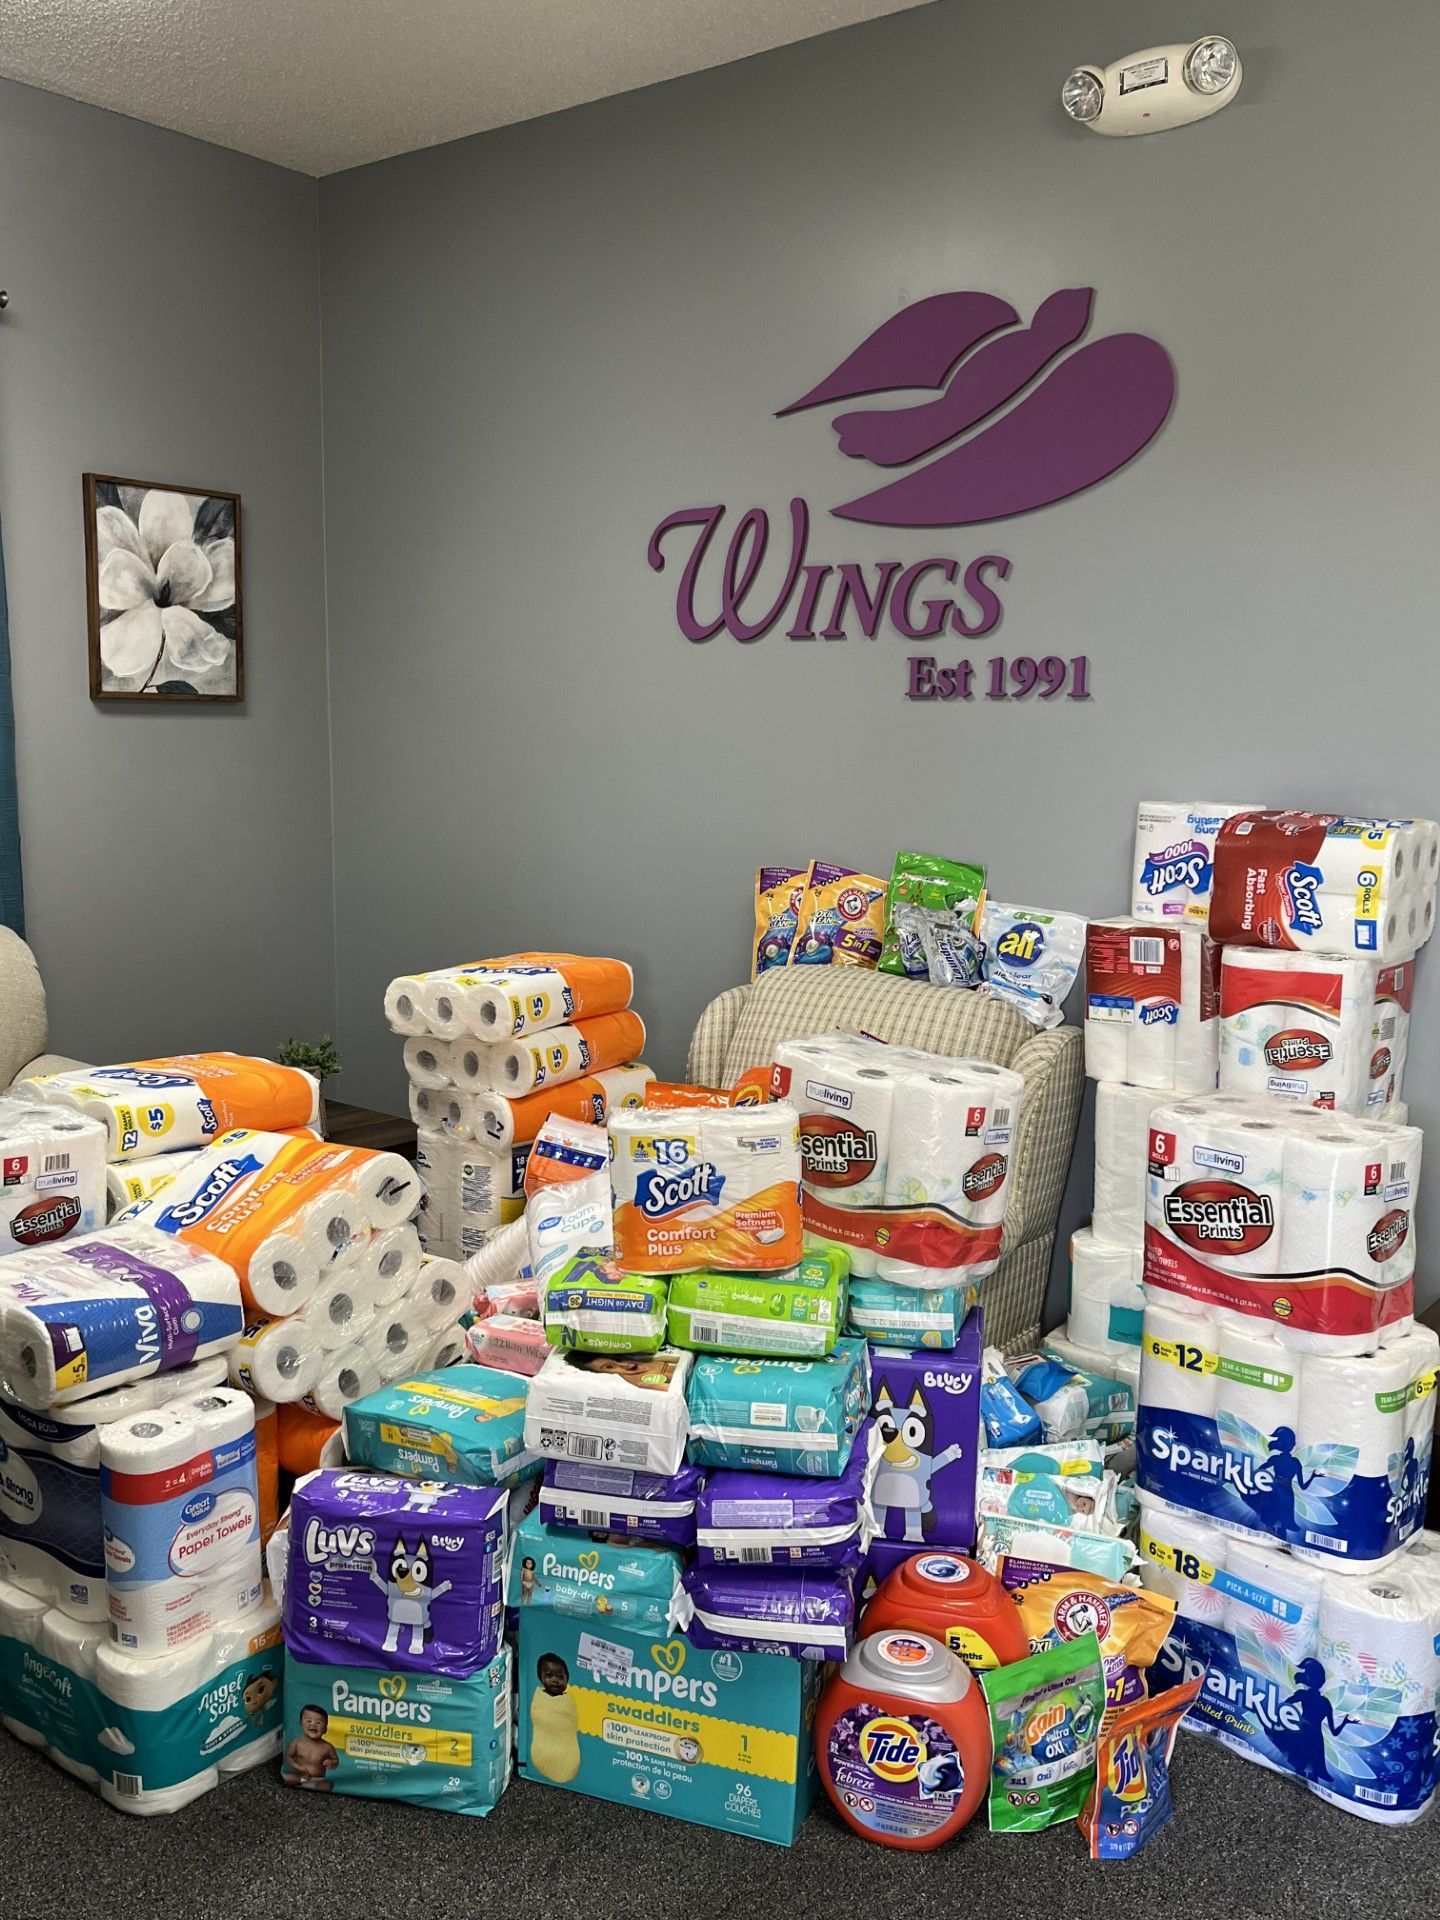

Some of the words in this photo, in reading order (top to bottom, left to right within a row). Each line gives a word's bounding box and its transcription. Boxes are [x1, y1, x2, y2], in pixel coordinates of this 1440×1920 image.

[906, 656, 973, 699] Est
[986, 655, 1091, 699] 1991
[1164, 840, 1194, 859] 1000
[1150, 858, 1204, 895] Scott
[1256, 868, 1268, 894] Fast
[1357, 871, 1378, 886] 6
[1241, 867, 1257, 930] Absorbing
[1290, 871, 1323, 929] Scott
[1361, 888, 1370, 914] ROLLS
[999, 930, 1040, 960] all
[533, 996, 544, 1017] $5
[562, 987, 574, 1015] Scott
[1145, 1005, 1174, 1024] Scott
[513, 1015, 524, 1035] 12
[1281, 1038, 1309, 1047] Prints
[553, 1048, 563, 1069] $5
[580, 1041, 590, 1070] Scott
[1265, 1043, 1332, 1064] Essential
[534, 1067, 546, 1085] 12
[773, 1066, 782, 1086] 6
[809, 1083, 850, 1107] trueliving
[150, 1107, 165, 1131] $5
[202, 1101, 218, 1131] Scott
[592, 1096, 604, 1123] Scott
[973, 1108, 982, 1122] 6
[122, 1130, 138, 1152] 12
[222, 1131, 248, 1145] $5
[1155, 1133, 1166, 1154] 6
[516, 1156, 525, 1165] 18
[636, 1140, 645, 1149] 4
[653, 1140, 687, 1164] 16
[1151, 1151, 1169, 1162] ROLLS
[1196, 1150, 1241, 1171] trueliving
[12, 1158, 20, 1171] 6
[807, 1156, 848, 1173] Prints
[963, 1156, 1008, 1191] Essential
[1370, 1165, 1377, 1180] 6
[37, 1173, 76, 1188] trueliving
[645, 1163, 713, 1213] Scott
[171, 1161, 243, 1226] Scott
[205, 1169, 289, 1232] Comfort
[10, 1196, 82, 1237] Essential
[217, 1200, 264, 1235] Plus
[734, 1210, 778, 1219] Premium
[1166, 1196, 1272, 1226] Essential
[35, 1219, 64, 1237] Prints
[735, 1218, 777, 1227] Softness
[1200, 1223, 1243, 1240] Prints
[646, 1227, 718, 1243] Comfort
[1367, 1214, 1410, 1252] Essential
[647, 1243, 684, 1257] Plus
[586, 1297, 611, 1308] NIGHT
[611, 1300, 620, 1308] OR
[621, 1300, 644, 1311] DAY
[135, 1304, 160, 1364] Viva
[161, 1305, 174, 1350] Multi-Surface
[172, 1316, 180, 1336] Cloth
[560, 1325, 577, 1347] N
[888, 1333, 916, 1342] Pampers
[1152, 1342, 1160, 1355] 6
[1175, 1344, 1203, 1373] 12
[78, 1363, 85, 1374] 5
[713, 1355, 814, 1374] Pampers
[923, 1371, 973, 1395] BLUEY
[1416, 1380, 1423, 1394] 6
[409, 1394, 471, 1419] Pampers
[191, 1461, 212, 1476] Double
[398, 1448, 441, 1473] Pampers
[741, 1456, 777, 1470] Pampers
[1150, 1428, 1274, 1496] Sparkle
[5, 1475, 34, 1504] Strong
[165, 1480, 172, 1489] 2
[177, 1472, 186, 1484] 4
[331, 1474, 400, 1489] Luvs
[337, 1489, 350, 1498] 3
[1384, 1476, 1430, 1526] Sparkle
[185, 1496, 210, 1515] Great
[190, 1504, 211, 1518] Value
[1022, 1497, 1055, 1511] Pampers
[185, 1520, 219, 1541] Everyday
[219, 1508, 242, 1526] Strong
[178, 1532, 215, 1560] Paper
[216, 1513, 253, 1540] Towels
[431, 1534, 465, 1552] BLUEY
[112, 1552, 132, 1565] Towels
[1148, 1541, 1157, 1556] 6
[329, 1561, 374, 1572] protection
[542, 1552, 616, 1591] Pampers
[1008, 1559, 1050, 1569] ELIMINATES
[1008, 1563, 1033, 1571] TOUGH
[1172, 1548, 1200, 1580] 18
[555, 1583, 597, 1601] baby-dry
[1011, 1593, 1025, 1602] 42
[1225, 1580, 1268, 1607] PICK-A-SIZE
[620, 1601, 628, 1612] 5
[649, 1604, 659, 1613] 24
[1056, 1599, 1071, 1623] ARM
[1070, 1595, 1078, 1605] &
[1078, 1594, 1108, 1628] HAMMER
[309, 1616, 318, 1628] 3
[252, 1635, 266, 1649] 16
[323, 1630, 334, 1639] 32
[718, 1654, 733, 1667] #1
[1160, 1635, 1302, 1731] Sparkle
[197, 1672, 244, 1715] Angel
[331, 1679, 432, 1724] Pampers
[208, 1694, 240, 1724] Soft
[606, 1701, 701, 1733] swaddlers
[350, 1724, 414, 1741] swaddlers
[1024, 1703, 1066, 1746] Gain
[1224, 1710, 1256, 1736] Prints
[350, 1746, 364, 1755] skin
[364, 1748, 401, 1759] protection
[450, 1738, 459, 1749] 2
[606, 1731, 624, 1744] skin
[625, 1736, 671, 1754] protection
[740, 1735, 748, 1752] 1
[866, 1731, 921, 1765] Tide
[1045, 1740, 1066, 1759] OXI
[612, 1757, 651, 1774] protection
[651, 1765, 662, 1775] de
[662, 1767, 671, 1777] la
[672, 1771, 693, 1784] peau
[625, 1750, 643, 1762] 100
[650, 1757, 666, 1767] SANS
[666, 1761, 687, 1772] FUITES
[448, 1776, 460, 1786] 29
[835, 1766, 876, 1790] febreze
[1036, 1769, 1053, 1782] Oxi
[735, 1783, 752, 1797] 96
[724, 1801, 762, 1819] COUCHES
[728, 1793, 759, 1809] DIAPERS
